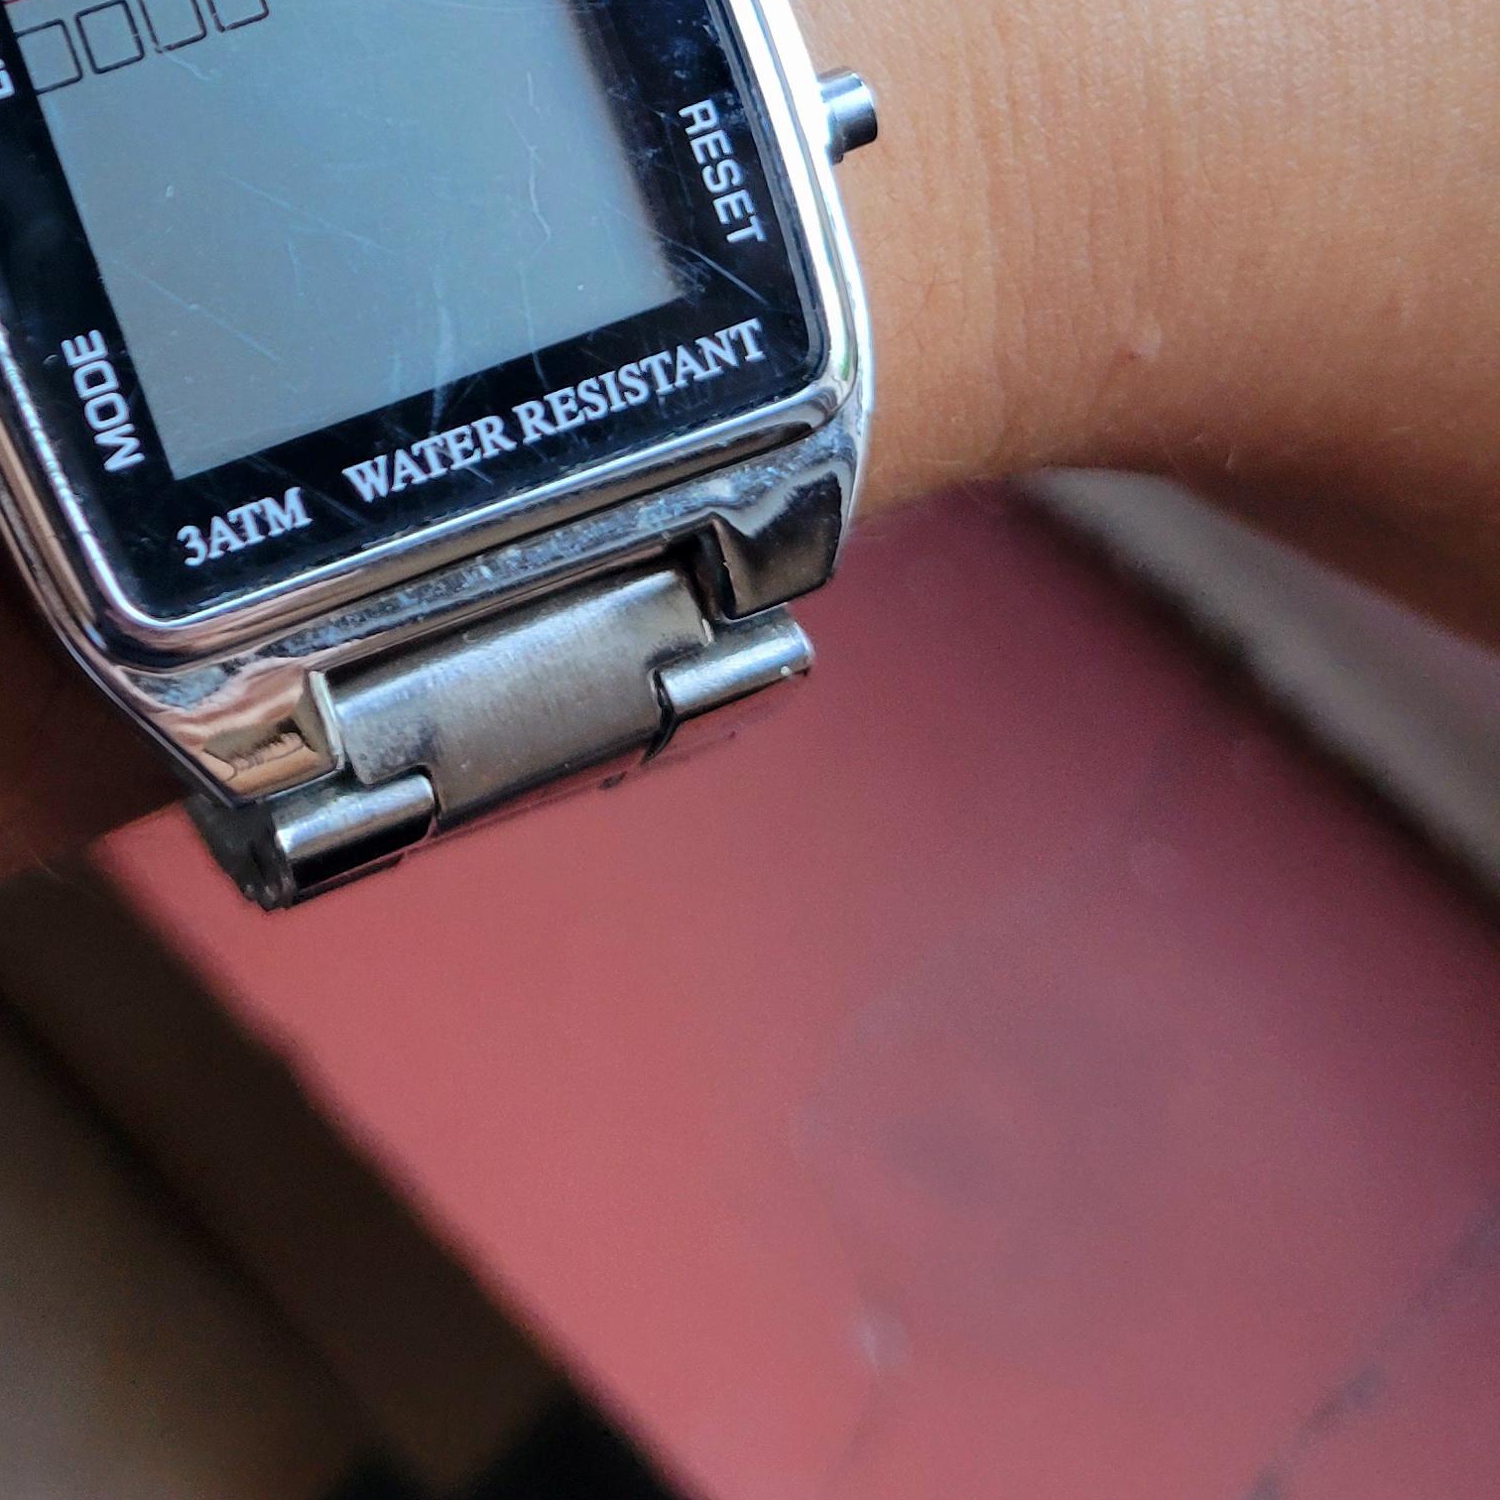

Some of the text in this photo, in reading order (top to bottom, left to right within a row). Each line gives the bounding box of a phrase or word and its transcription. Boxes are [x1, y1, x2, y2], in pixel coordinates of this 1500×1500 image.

[678, 99, 767, 244] RESET
[61, 329, 145, 473] MODE
[176, 317, 765, 567] 3ATM WATER RESISTANT
